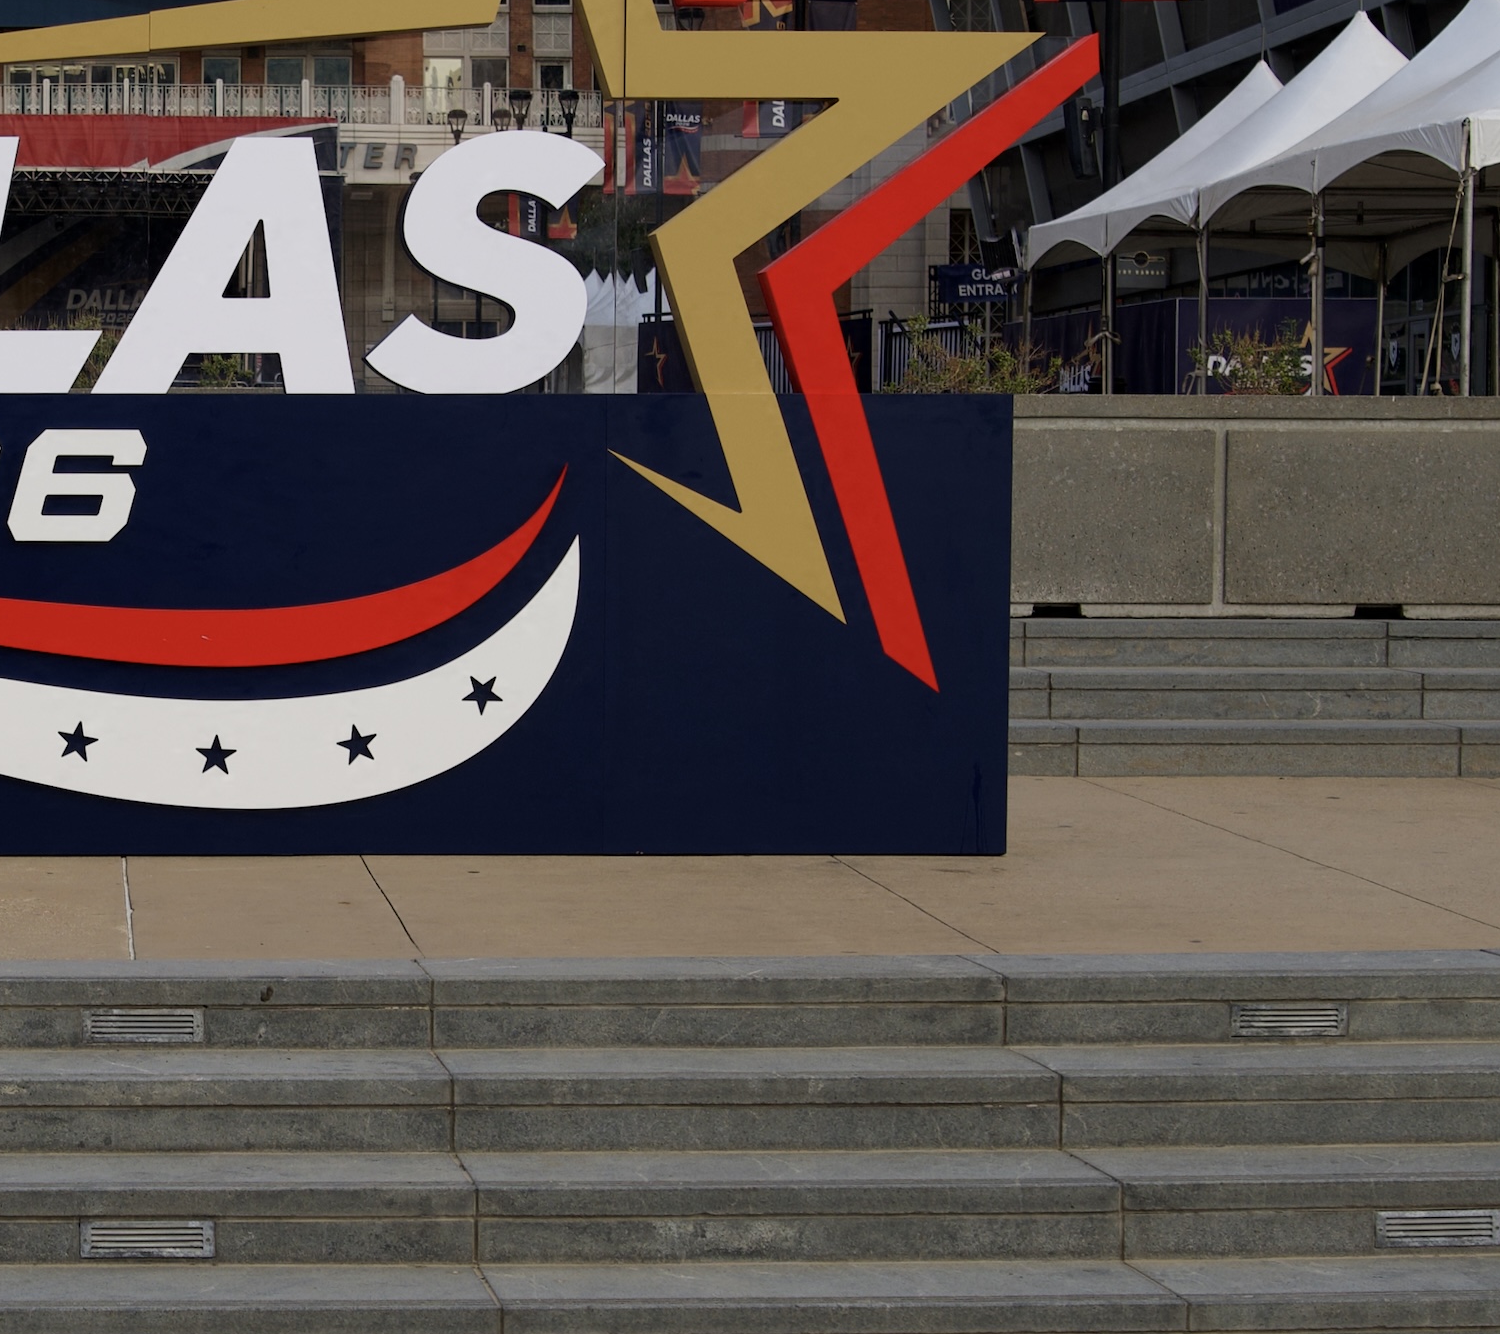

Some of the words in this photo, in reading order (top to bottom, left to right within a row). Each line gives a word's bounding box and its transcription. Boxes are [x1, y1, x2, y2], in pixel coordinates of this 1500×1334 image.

[666, 114, 701, 123] DALLAS
[771, 100, 785, 128] DAL
[643, 138, 652, 187] DALLAS
[66, 289, 146, 310] DALLA
